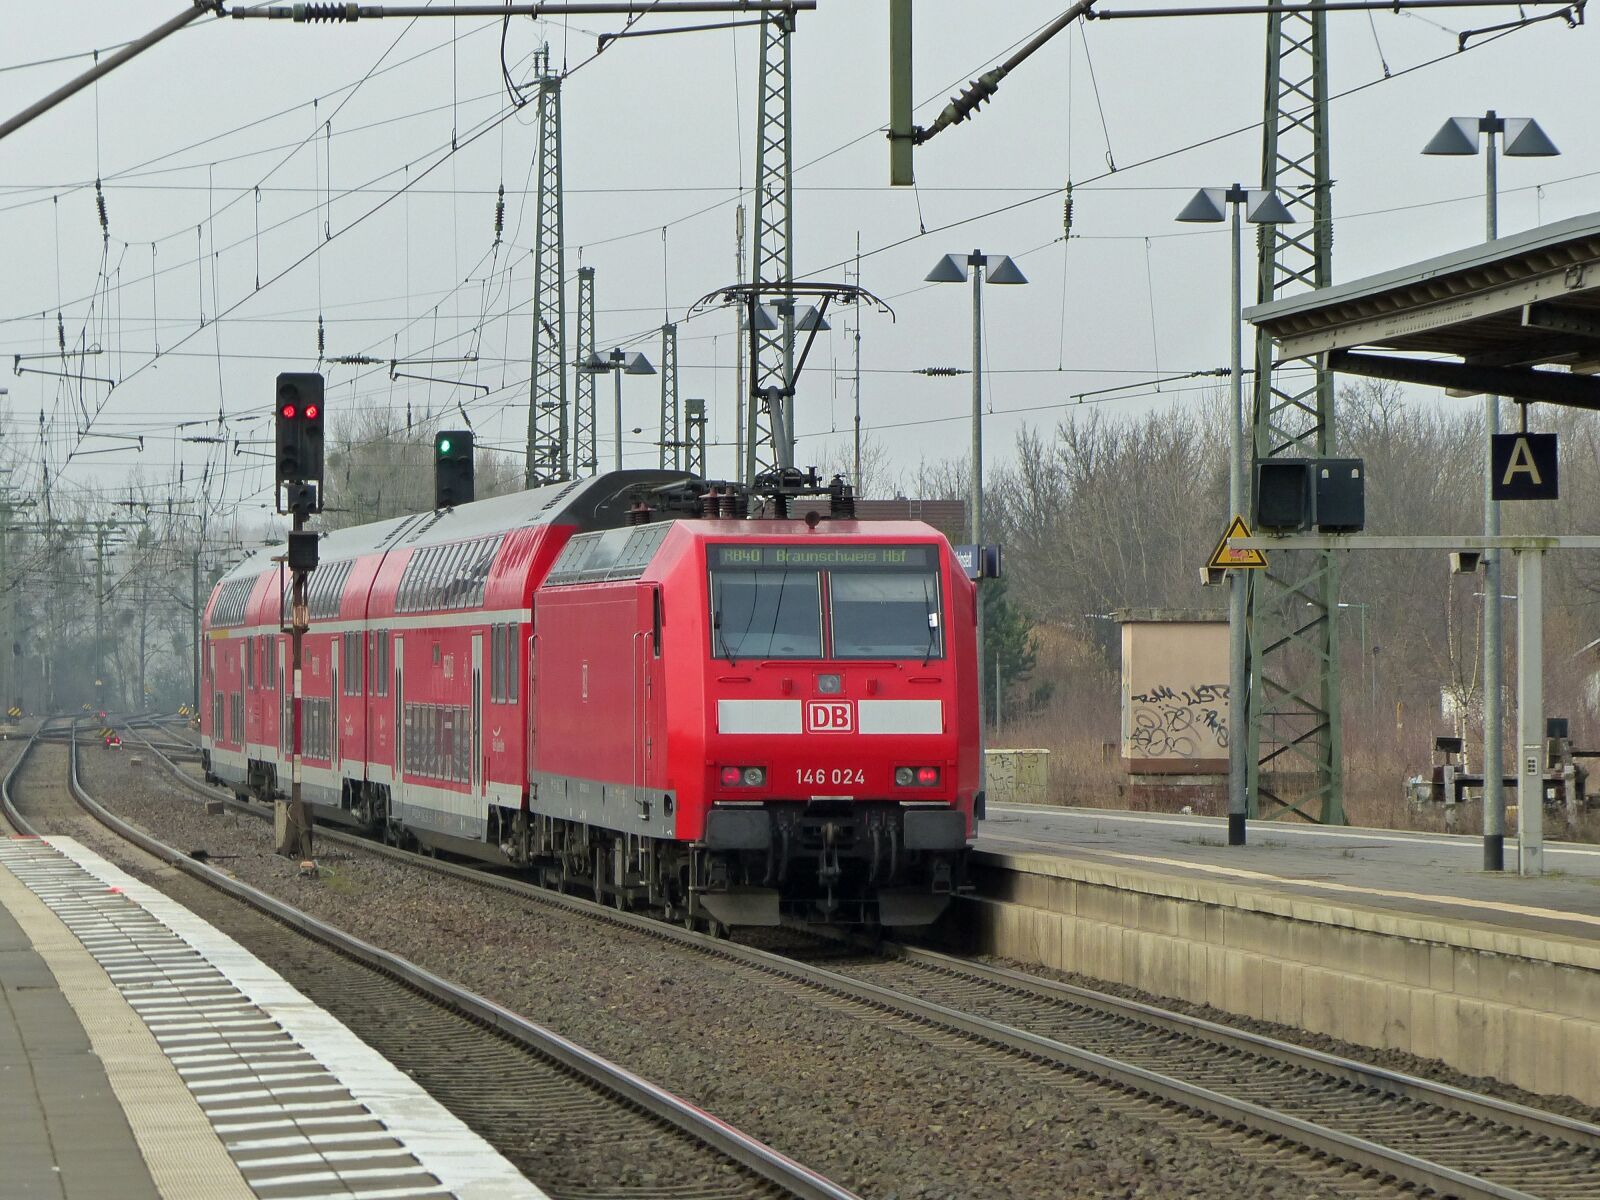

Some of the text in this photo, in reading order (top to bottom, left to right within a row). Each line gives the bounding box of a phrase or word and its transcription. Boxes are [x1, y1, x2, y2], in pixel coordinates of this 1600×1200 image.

[1502, 437, 1542, 485] A
[724, 550, 907, 562] RB40 Braunschweig Hbf
[812, 705, 849, 728] DB
[796, 768, 865, 784] 146 024
